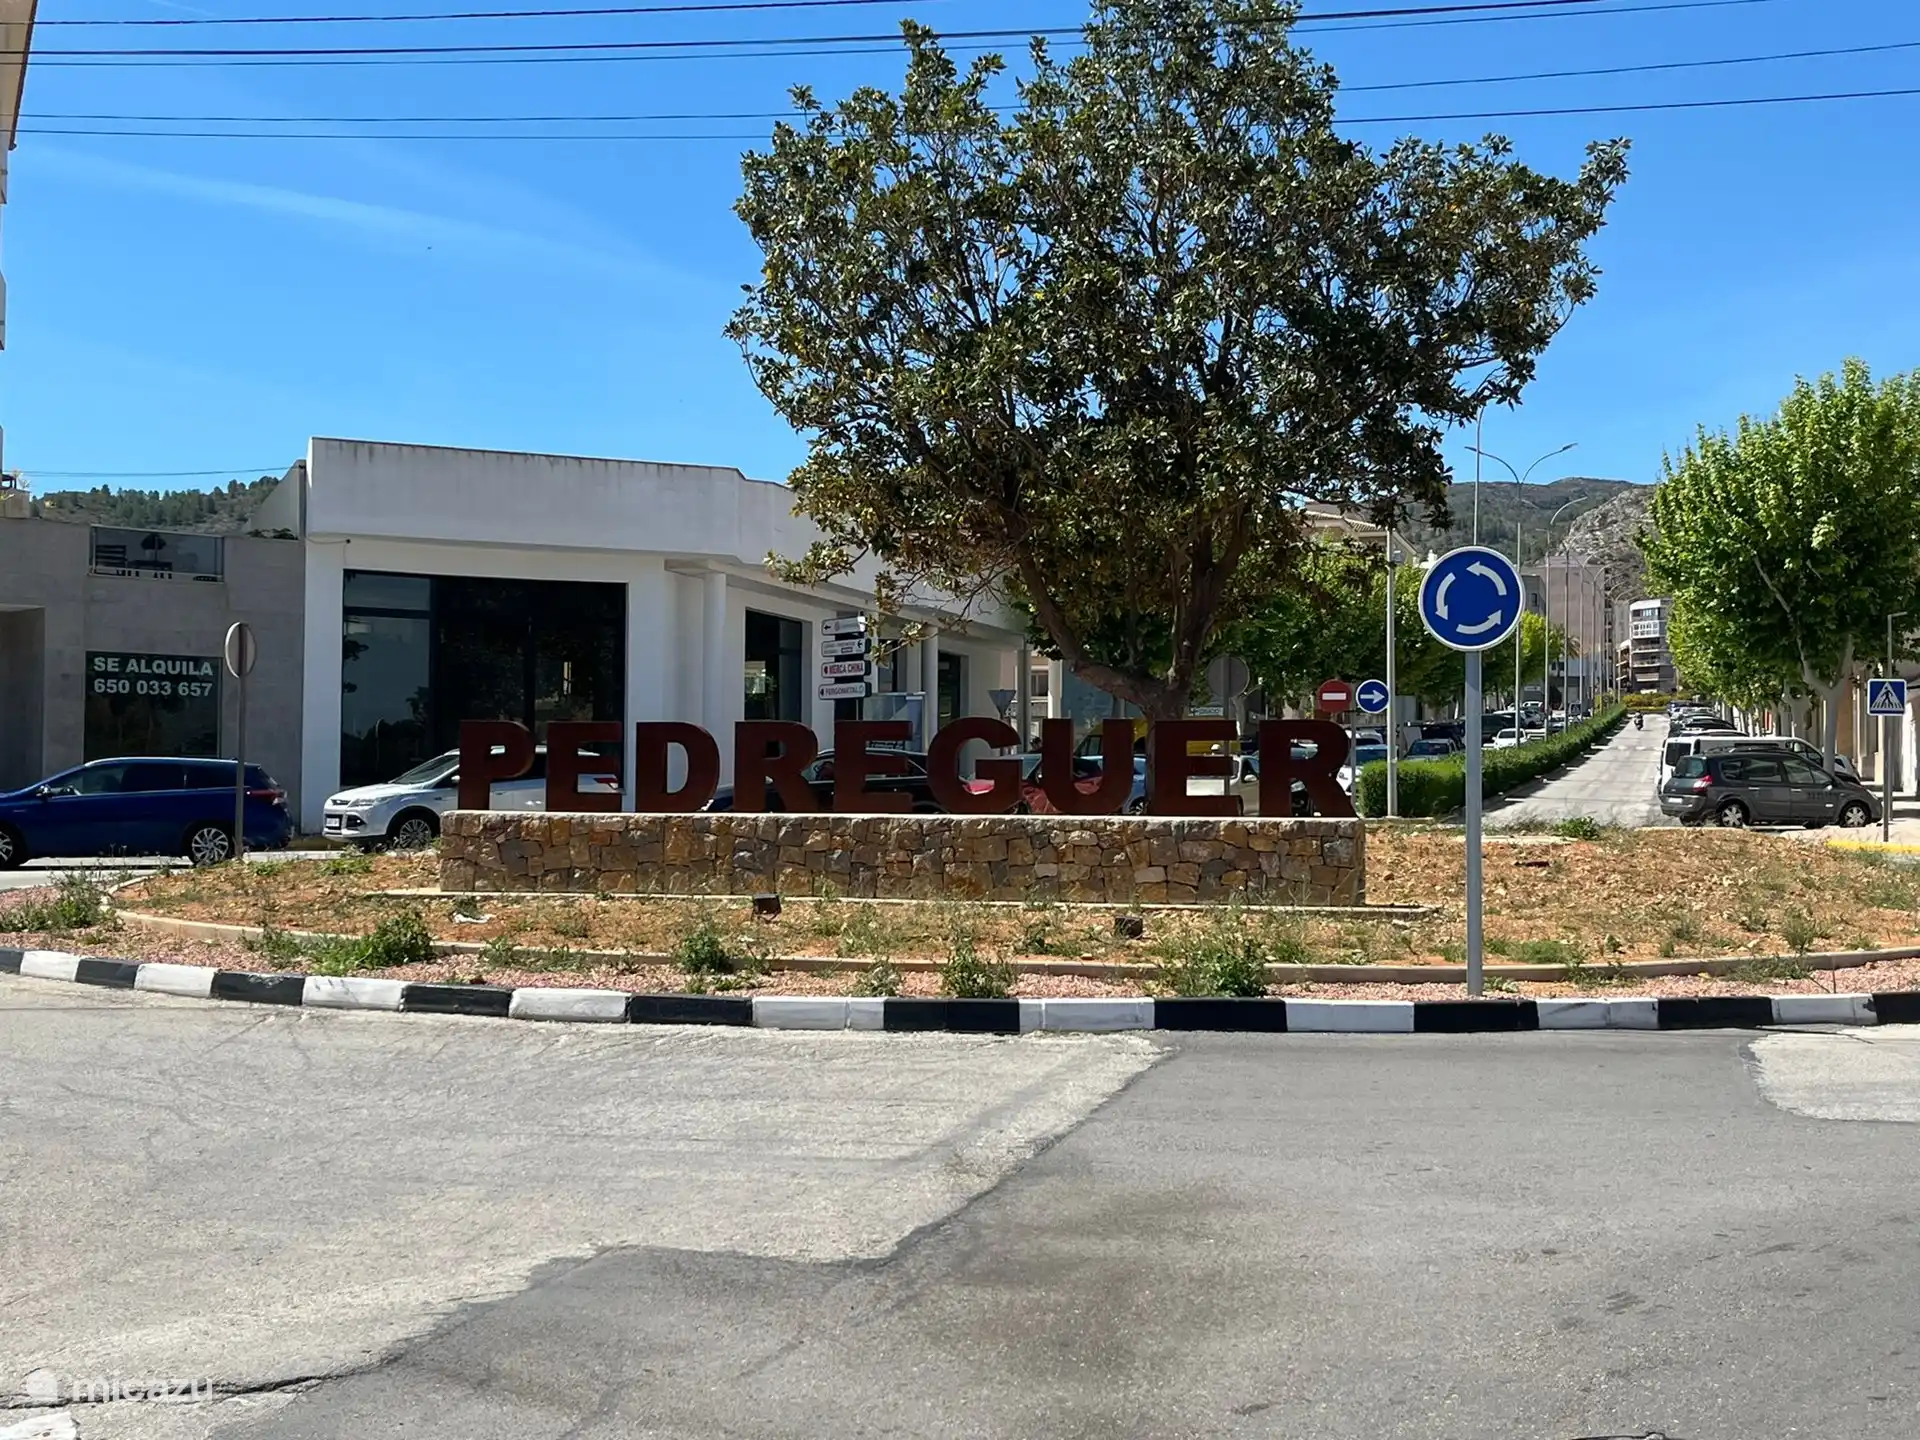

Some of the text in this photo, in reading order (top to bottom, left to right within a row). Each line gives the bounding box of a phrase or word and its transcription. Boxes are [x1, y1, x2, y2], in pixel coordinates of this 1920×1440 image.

[93, 656, 213, 676] SE ALQUILA
[828, 662, 863, 675] MERCA CHINA
[94, 678, 213, 697] 650 033 657
[458, 717, 1358, 817] PEDREGUER
